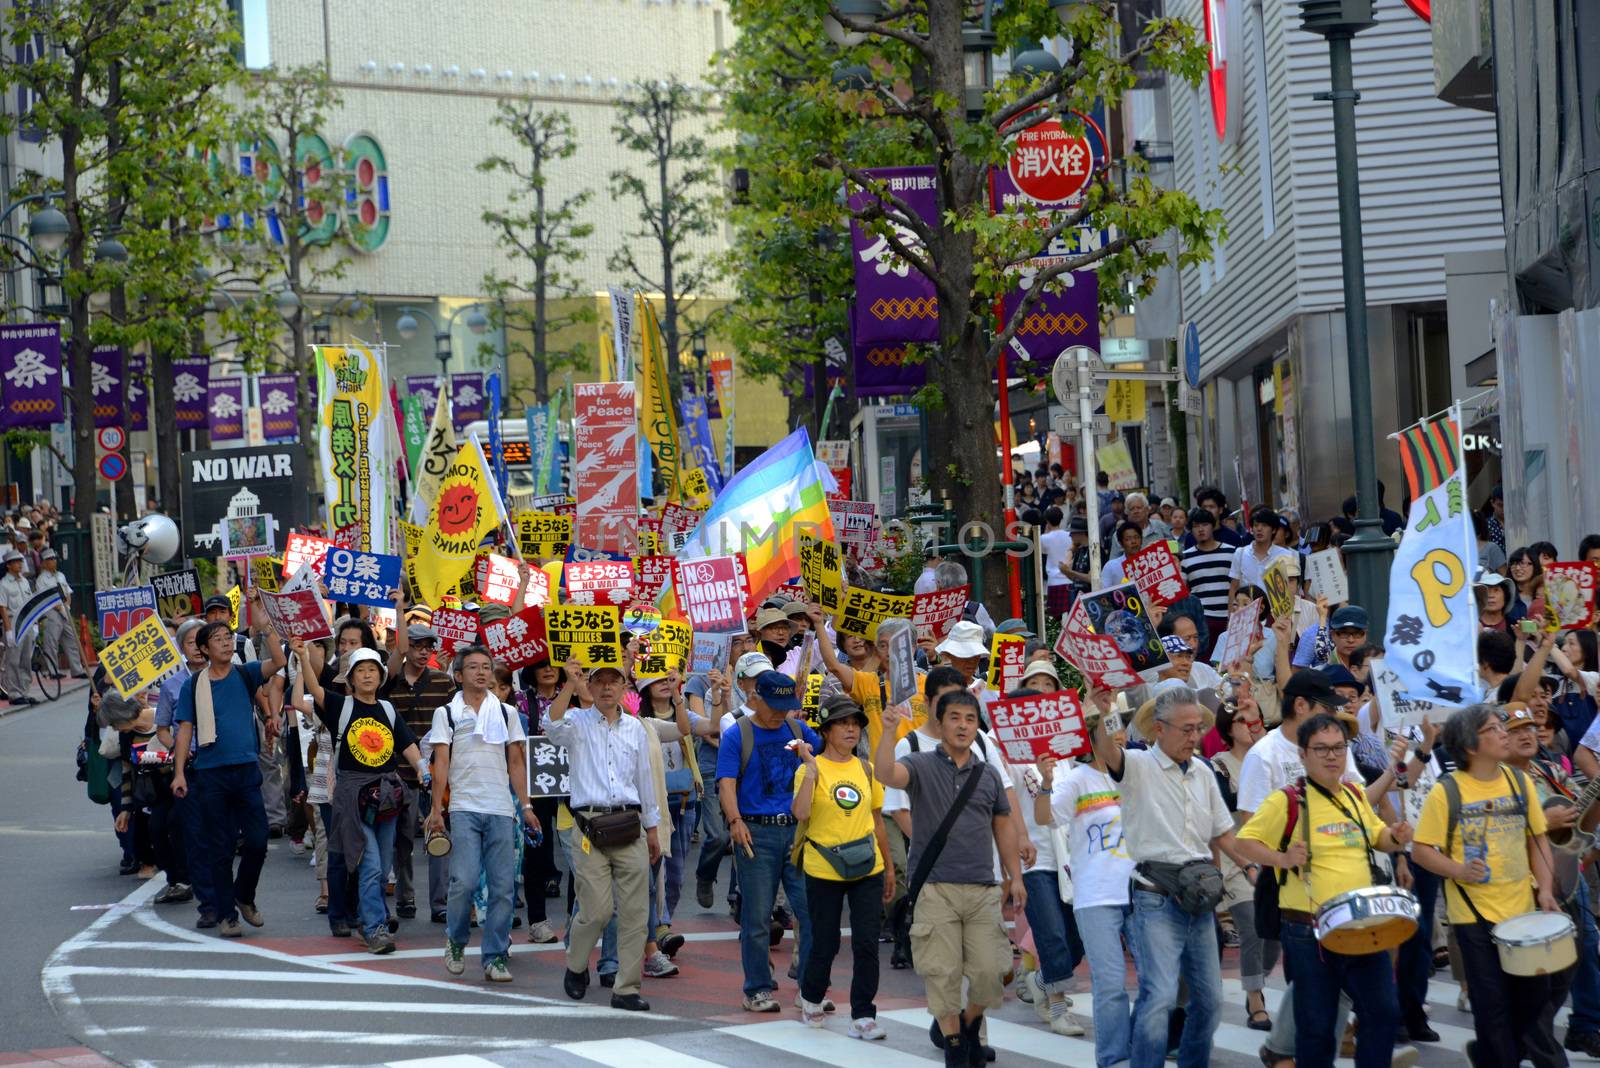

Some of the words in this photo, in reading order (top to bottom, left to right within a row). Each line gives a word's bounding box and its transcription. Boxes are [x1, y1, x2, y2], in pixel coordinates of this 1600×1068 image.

[1022, 132, 1039, 141] FIRE
[1017, 144, 1085, 178] 消火栓
[5, 348, 57, 389] 祭
[172, 372, 207, 402] 祭
[577, 384, 605, 397] ART
[209, 392, 242, 419] 祭
[261, 389, 296, 416] 祭
[587, 405, 633, 417] Peace
[596, 397, 612, 406] for
[104, 432, 119, 445] 30
[577, 441, 603, 449] Peace
[192, 458, 228, 483] NO
[230, 454, 293, 481] WAR
[521, 519, 570, 533] さようなら
[332, 550, 381, 580] 9条
[569, 564, 630, 581] さようなら
[597, 580, 619, 588] WAR
[1147, 570, 1164, 585] WAR
[688, 579, 737, 603] MORE
[690, 599, 733, 624] WAR
[1087, 600, 1101, 622] 9
[1127, 596, 1142, 618] 9
[432, 609, 478, 632] さようなら
[548, 609, 614, 630] さようなら
[105, 622, 159, 668] さようなら
[446, 629, 465, 640] WAR
[559, 631, 570, 642] NO
[572, 631, 603, 643] NUKES
[551, 643, 618, 664] 原発
[992, 695, 1077, 726] さようなら
[1013, 727, 1029, 739] NO
[1032, 721, 1062, 736] WAR
[1003, 732, 1085, 760] 戦争
[1374, 898, 1396, 913] NO
